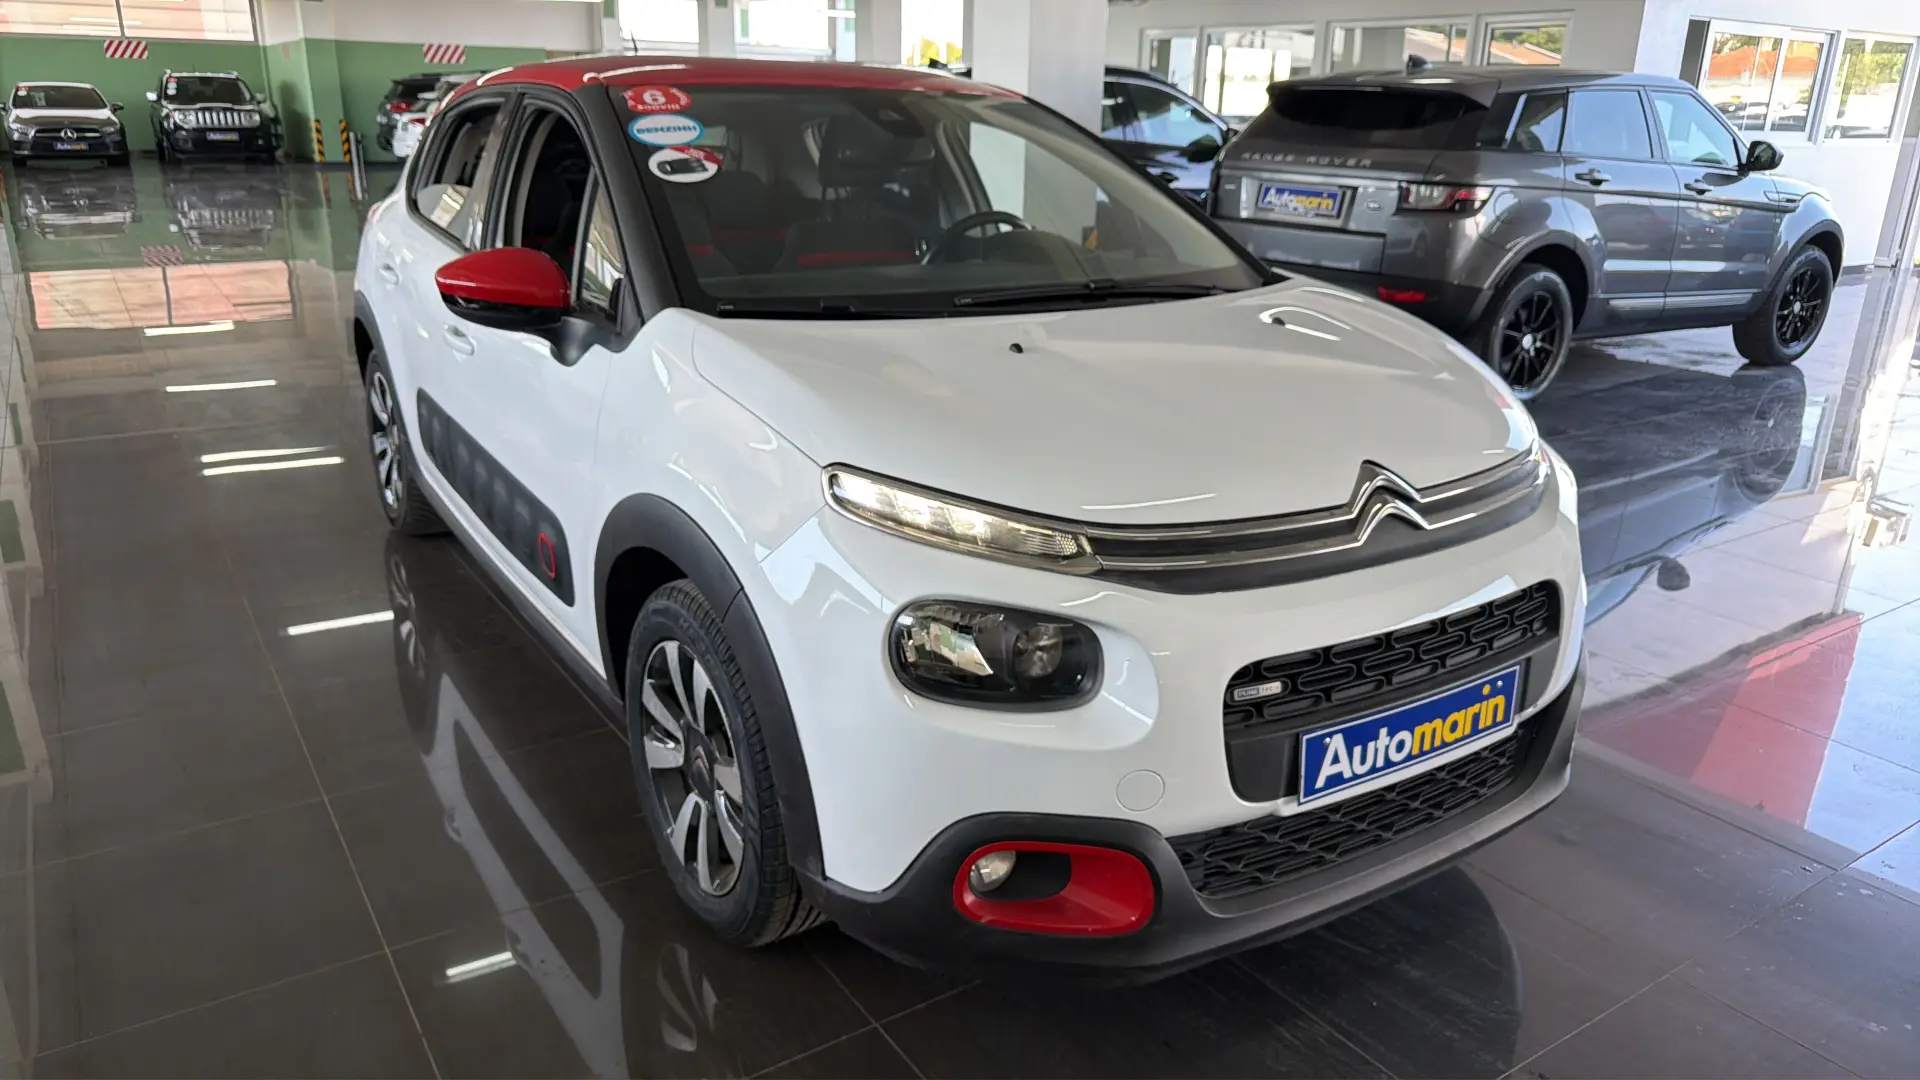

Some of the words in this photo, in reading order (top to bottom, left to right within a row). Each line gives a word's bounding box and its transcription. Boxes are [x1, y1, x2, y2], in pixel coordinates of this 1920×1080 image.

[642, 89, 667, 105] 6
[1306, 156, 1371, 168] ROVER
[1314, 684, 1506, 789] Automarin
